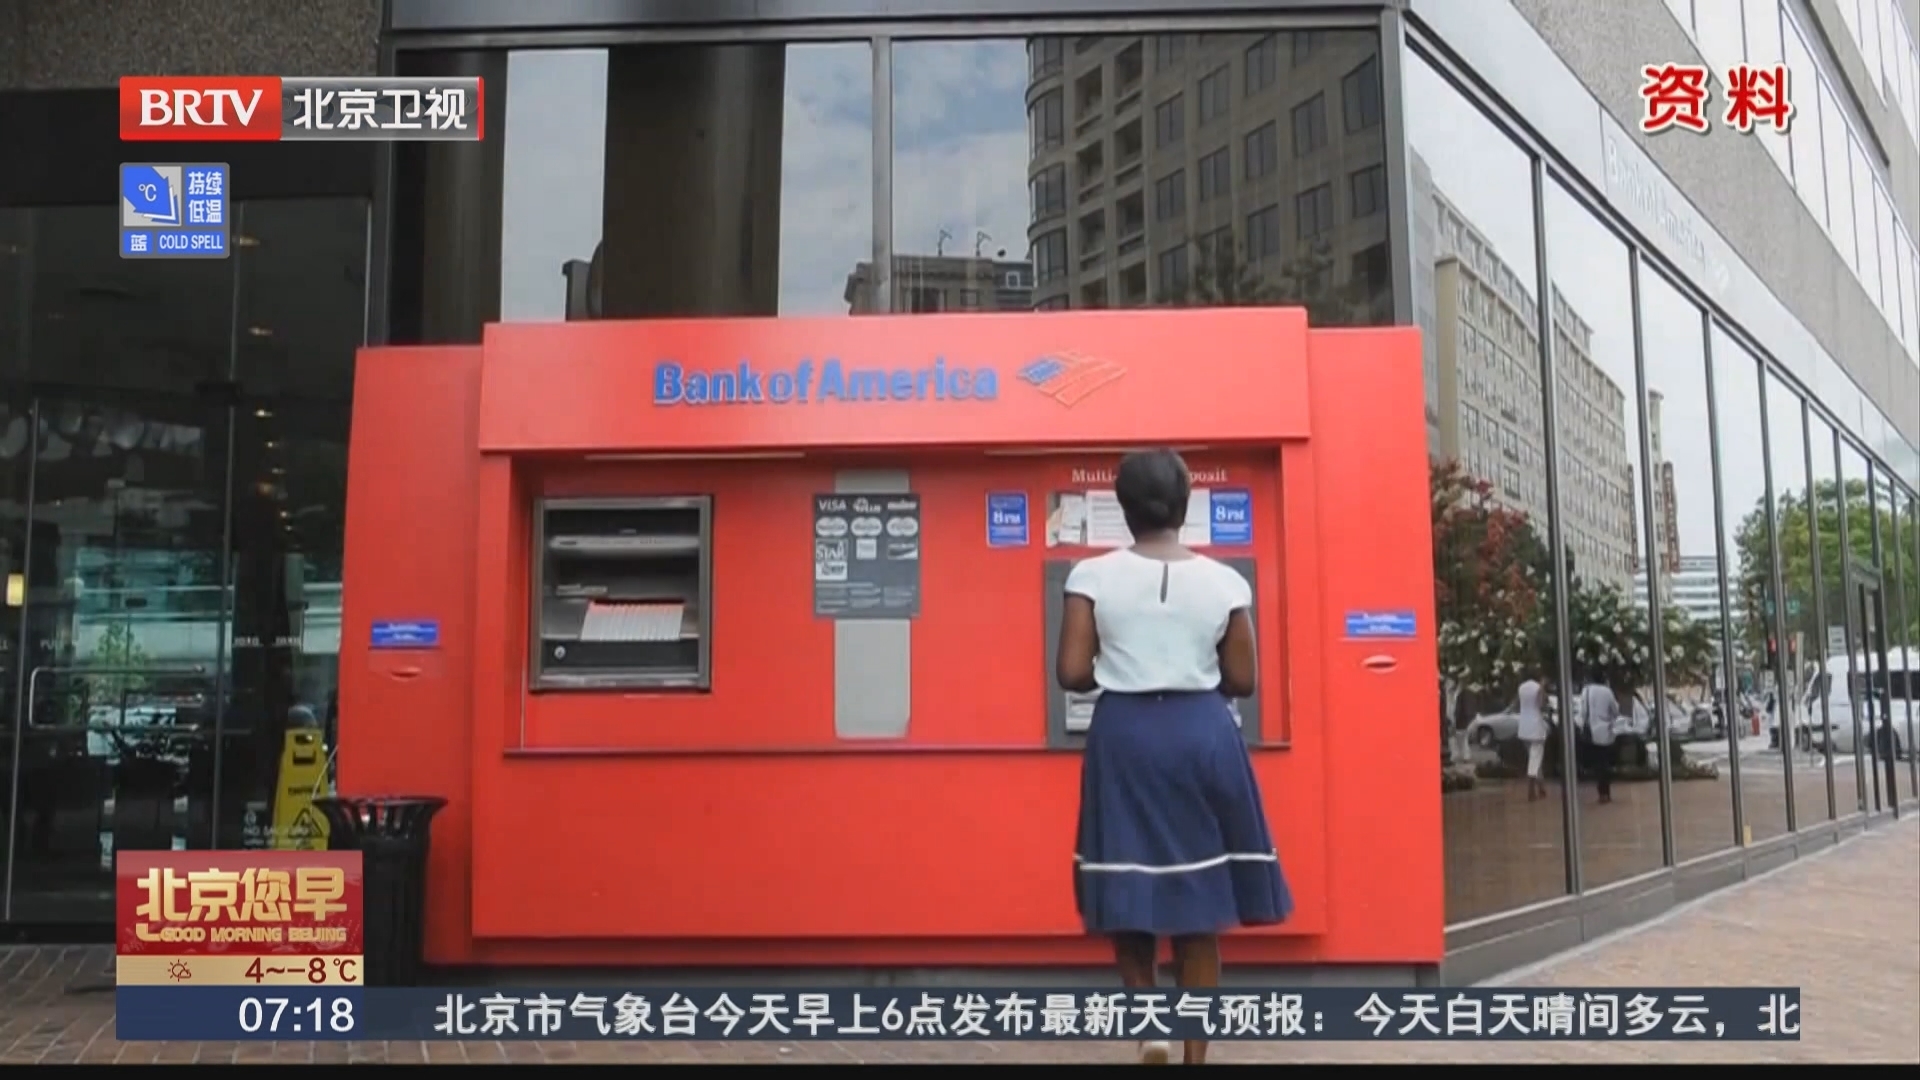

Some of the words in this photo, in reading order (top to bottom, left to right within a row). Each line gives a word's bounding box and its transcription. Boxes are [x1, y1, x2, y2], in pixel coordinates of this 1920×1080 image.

[653, 358, 765, 405] Bank
[768, 357, 813, 403] of
[817, 355, 999, 403] America
[1071, 468, 1116, 483] Multi-
[1190, 468, 1227, 484] posit
[819, 499, 847, 511] VISA
